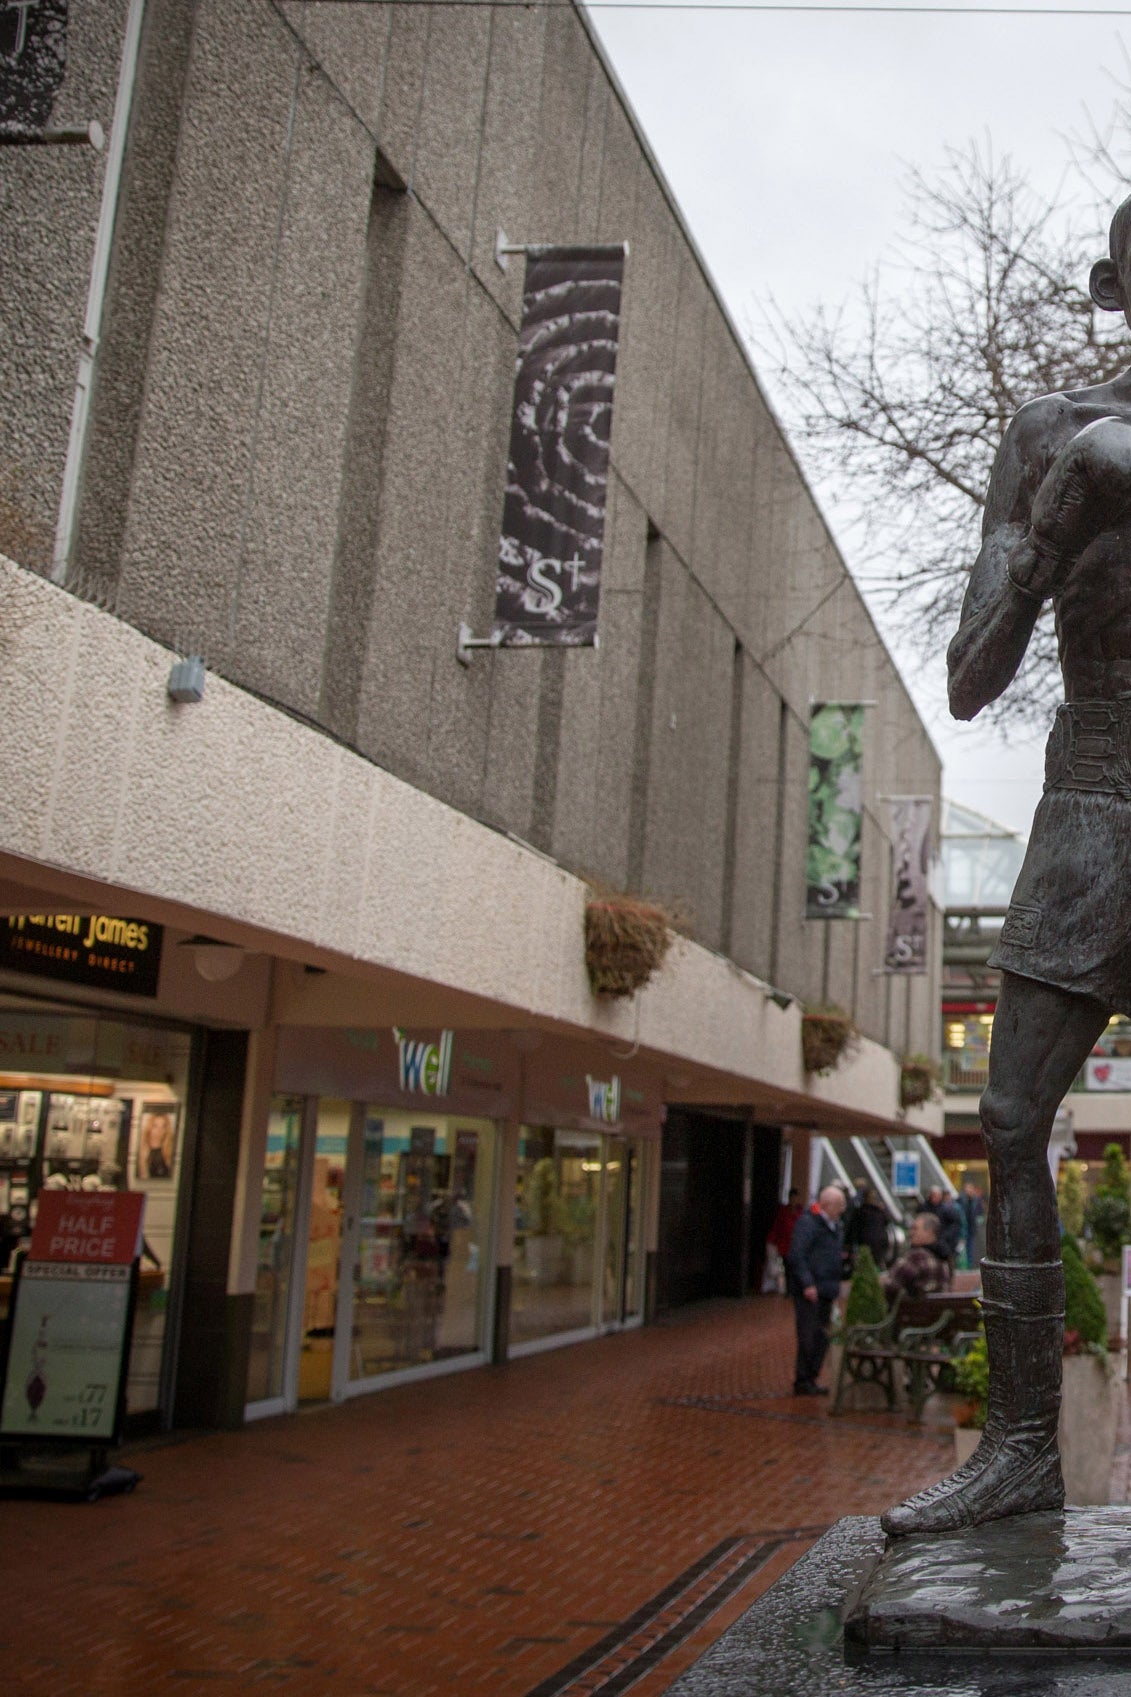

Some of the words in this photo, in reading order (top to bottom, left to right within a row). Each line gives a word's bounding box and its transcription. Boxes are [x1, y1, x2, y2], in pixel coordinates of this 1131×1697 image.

[87, 953, 135, 973] DIRECT
[58, 1215, 117, 1236] HALF
[48, 1236, 117, 1258] PRICE
